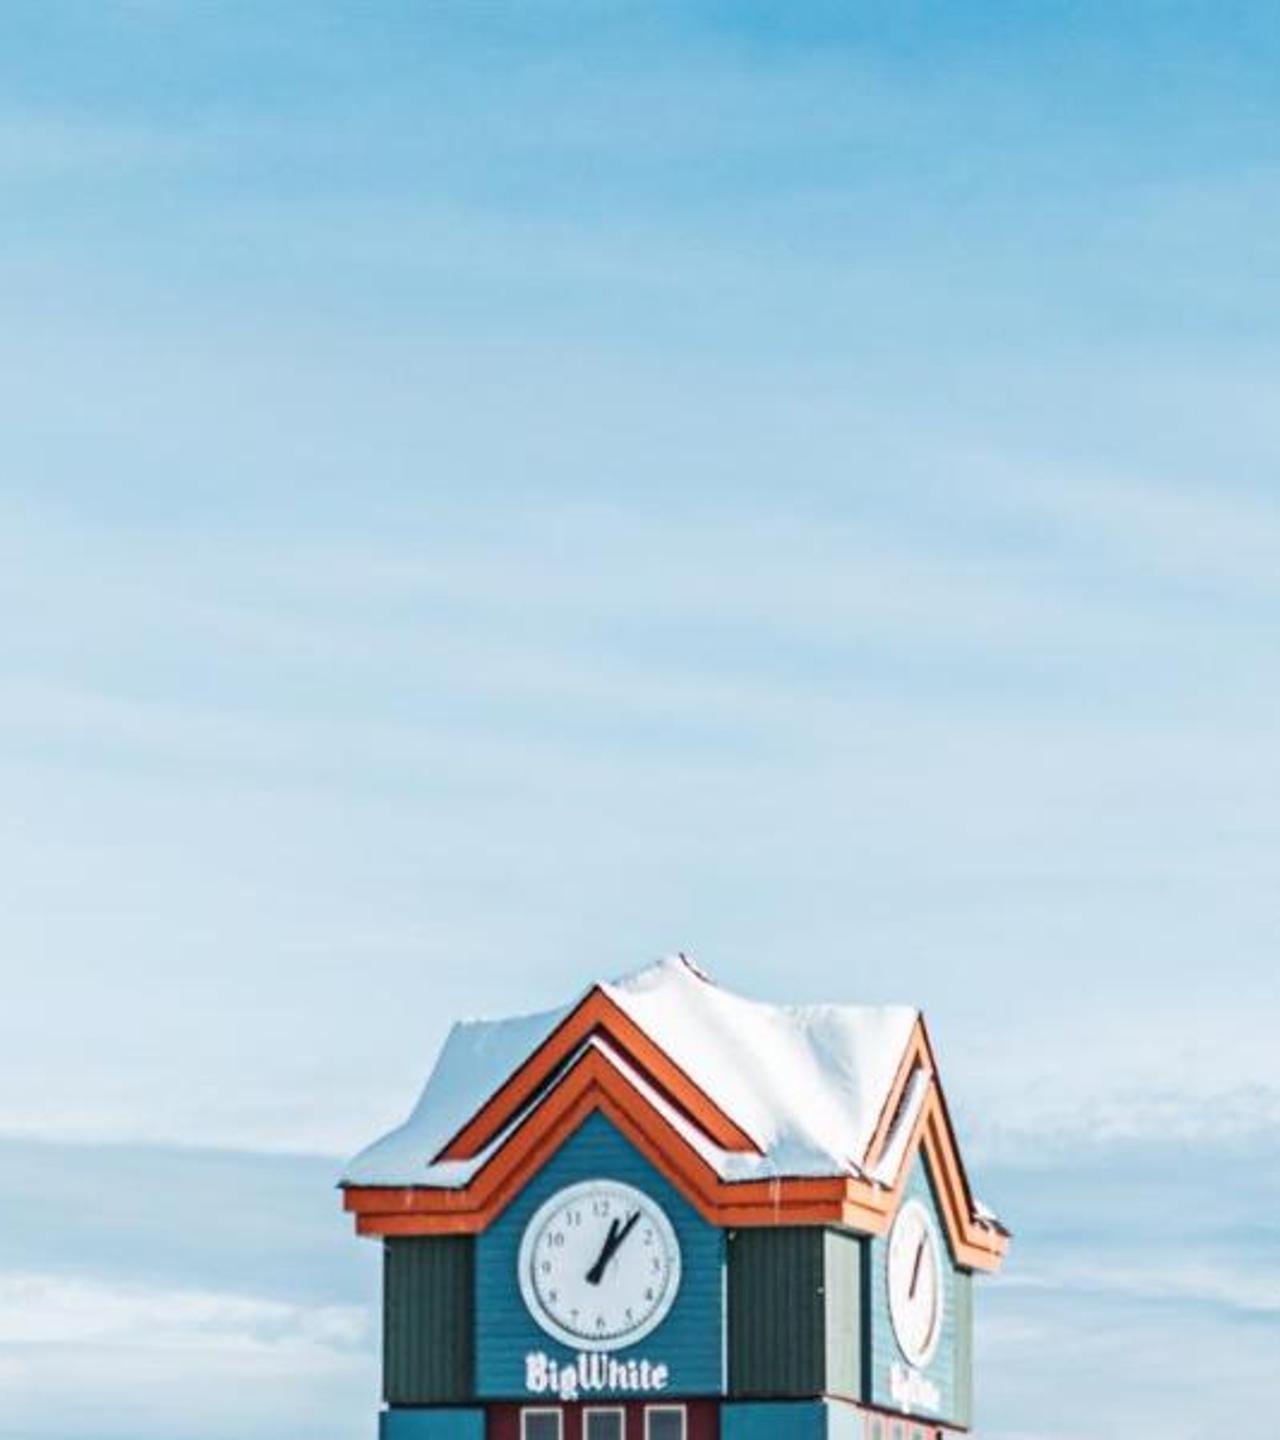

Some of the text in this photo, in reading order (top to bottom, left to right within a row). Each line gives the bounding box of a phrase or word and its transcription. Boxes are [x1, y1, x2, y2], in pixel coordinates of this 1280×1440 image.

[592, 1202, 609, 1217] 12
[566, 1211, 581, 1226] 11
[547, 1232, 564, 1247] 10
